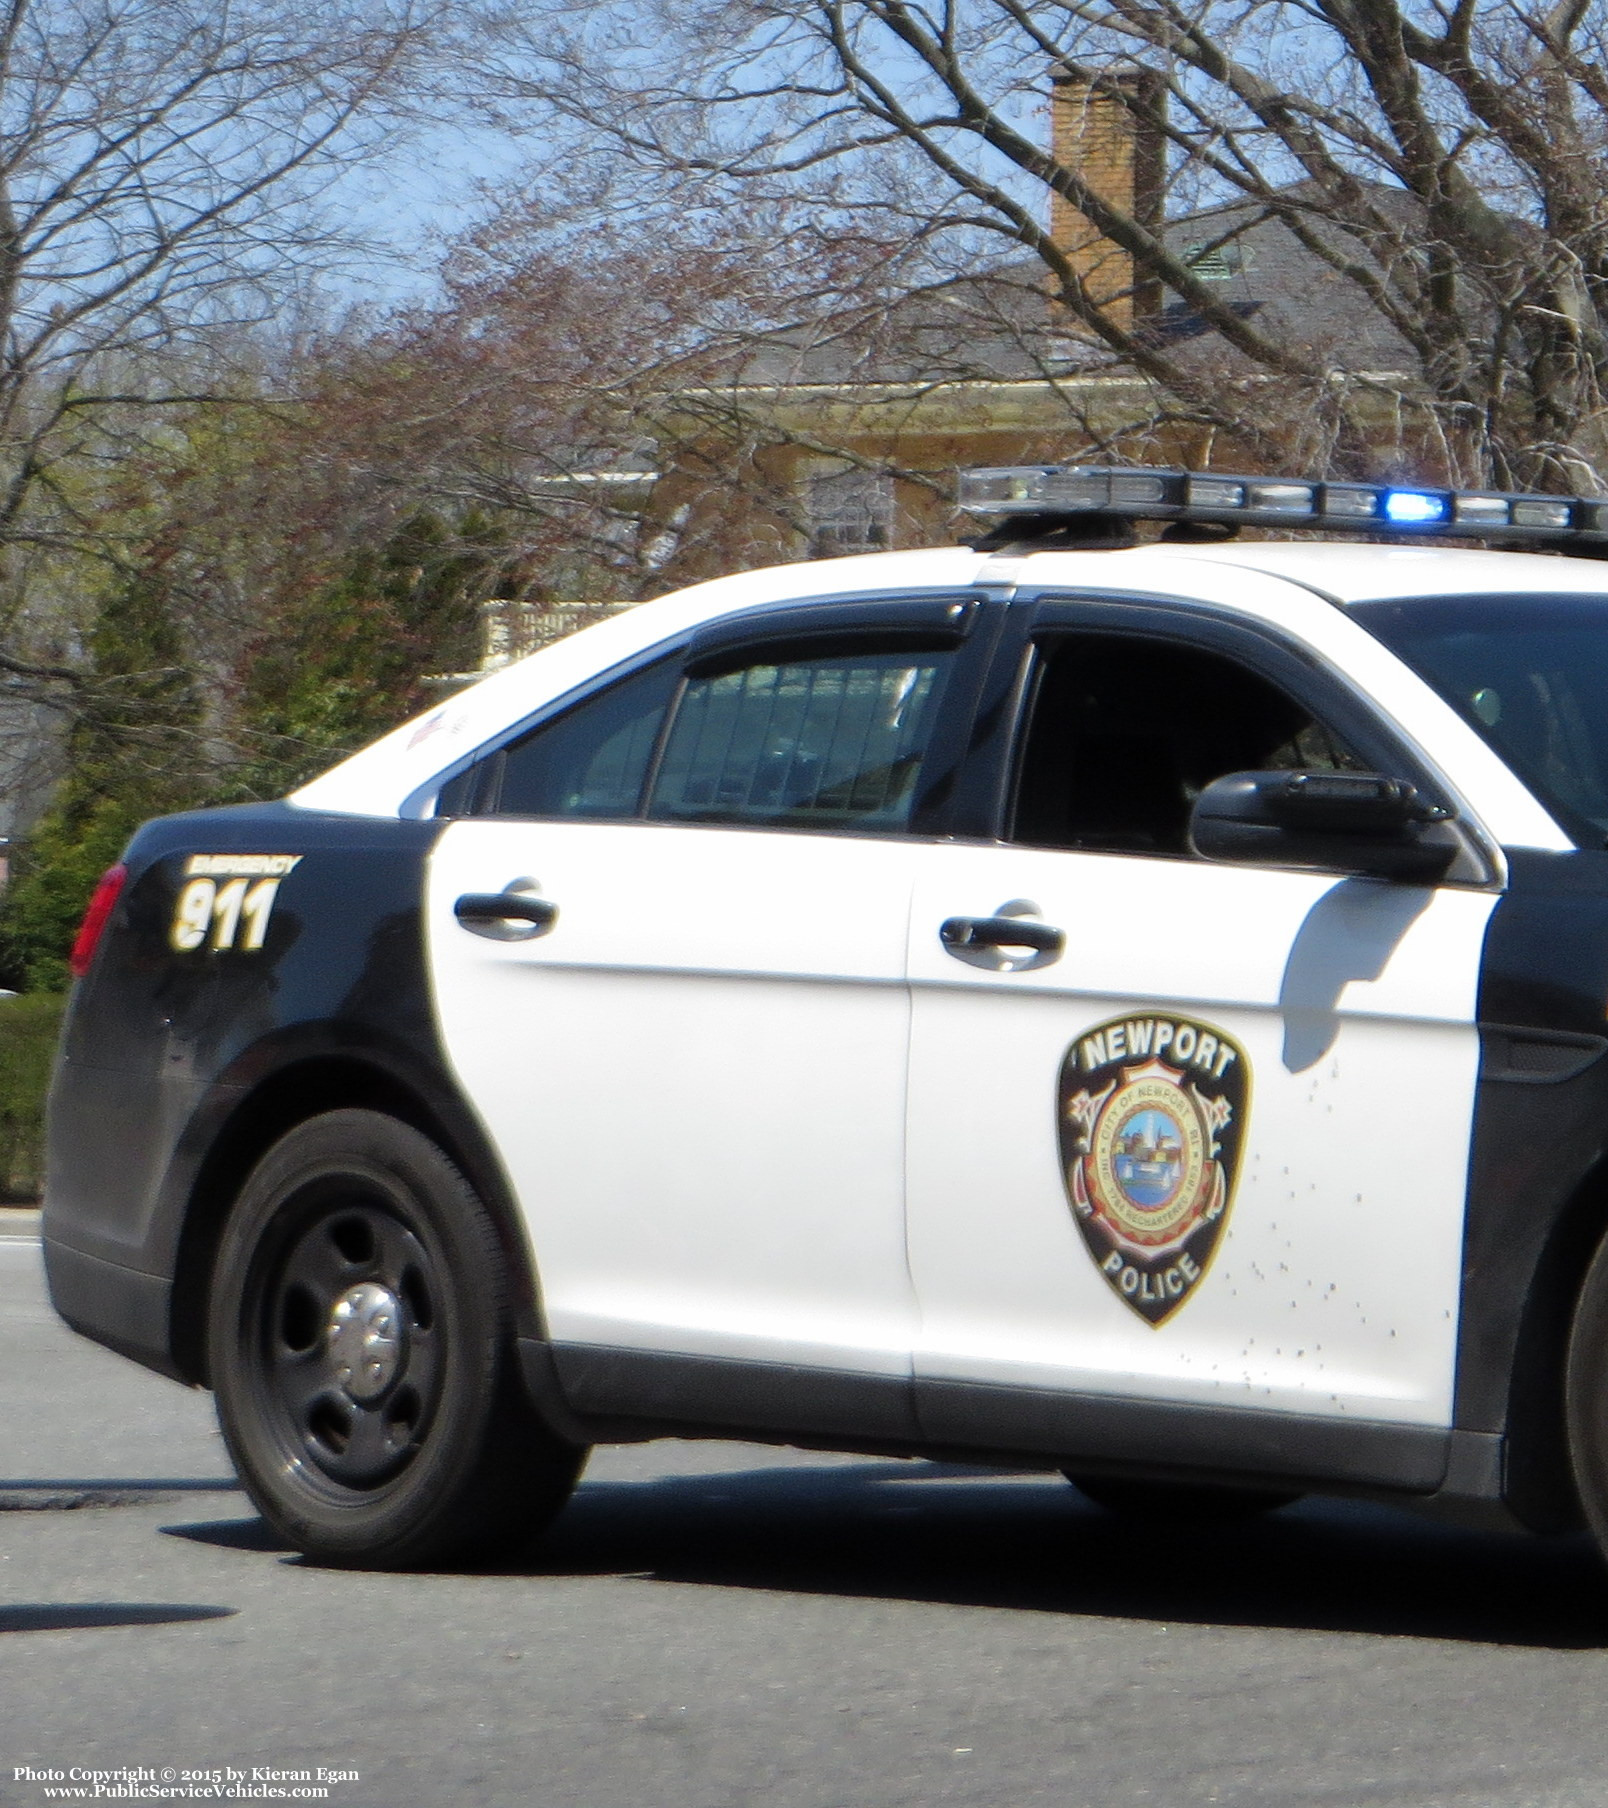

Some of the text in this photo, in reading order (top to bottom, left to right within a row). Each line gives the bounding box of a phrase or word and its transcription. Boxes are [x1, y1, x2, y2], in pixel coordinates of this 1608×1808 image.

[170, 877, 283, 950] 911
[1084, 1018, 1238, 1078] NEWPORT
[1102, 1250, 1201, 1301] POLICE
